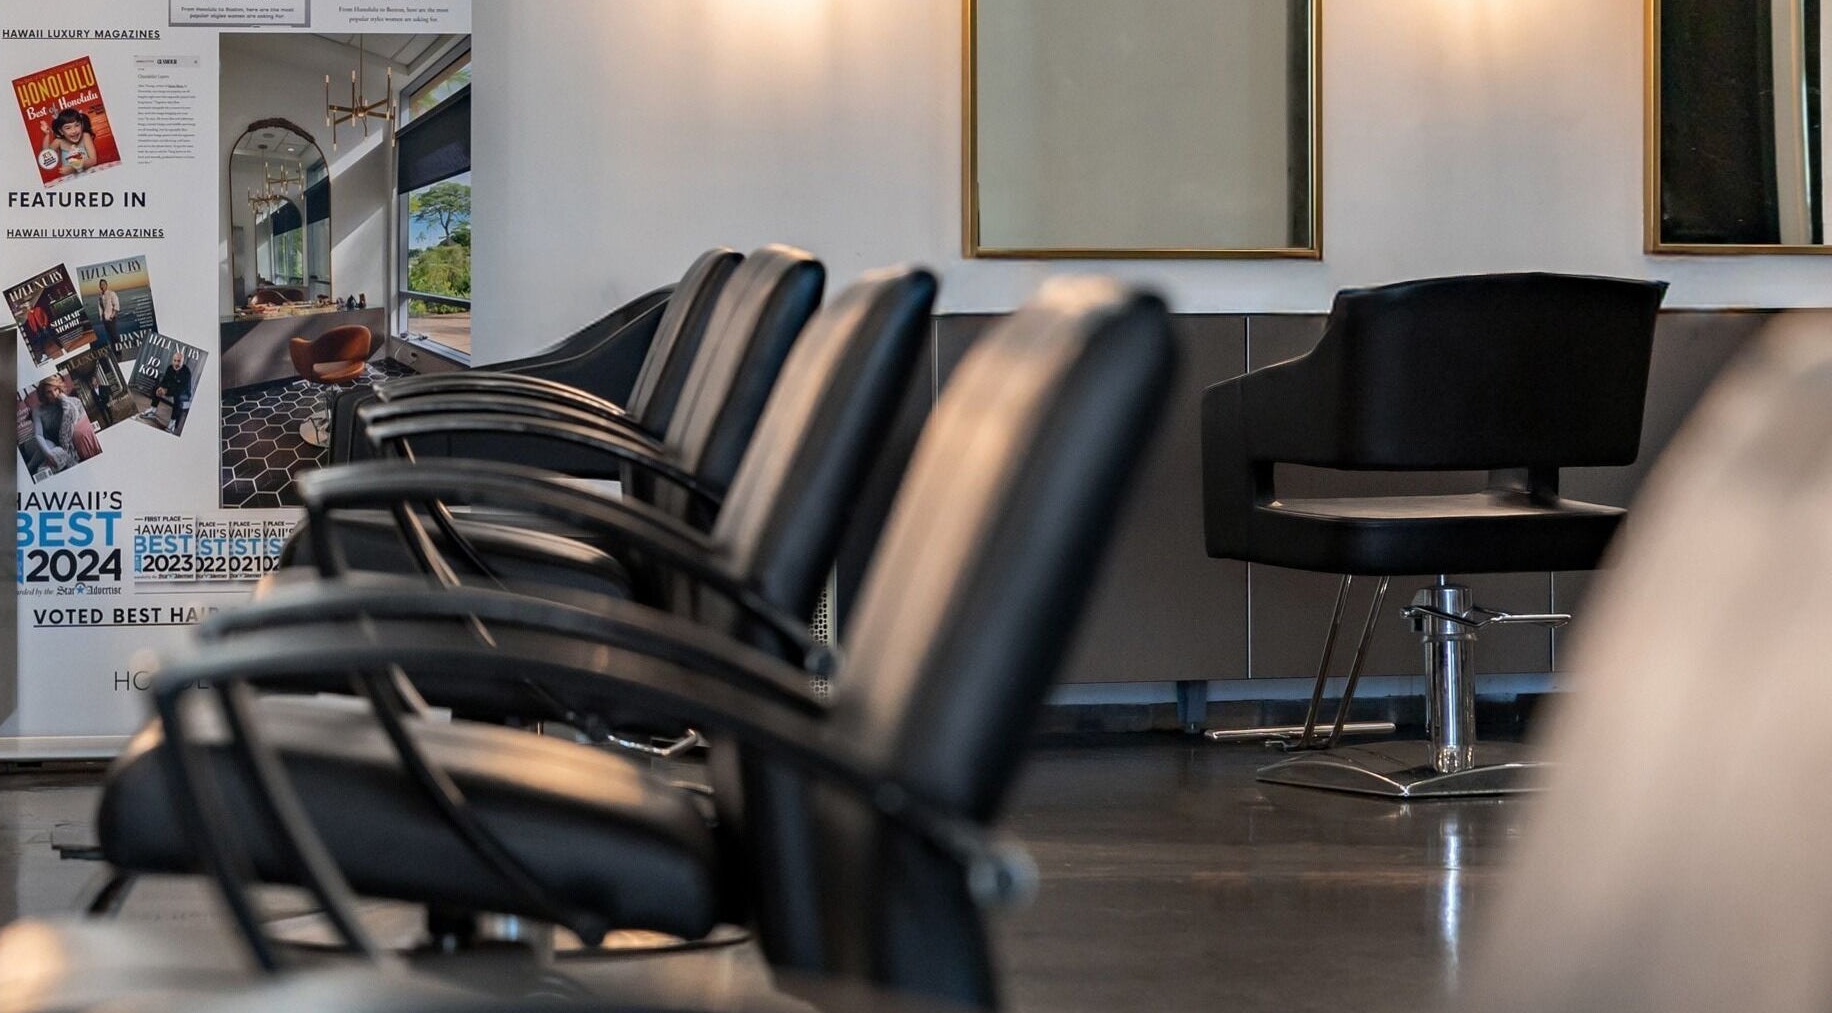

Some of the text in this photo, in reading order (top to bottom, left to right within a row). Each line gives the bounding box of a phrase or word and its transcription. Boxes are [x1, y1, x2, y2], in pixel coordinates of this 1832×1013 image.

[3, 30, 160, 38] HAWAII LUXURY MAGAZINES
[18, 64, 95, 108] HONOLULU
[27, 106, 47, 121] Best
[49, 103, 59, 117] of
[58, 92, 98, 110] Honolulu
[9, 192, 145, 207] FEATURED IN
[7, 229, 164, 237] HAWAII LUXURY MAGAZINES
[50, 311, 81, 327] SHEMAR
[55, 321, 81, 335] MOORE
[119, 329, 152, 342] DANI
[147, 356, 161, 368] JO
[139, 364, 160, 379] KOY
[17, 511, 122, 547] BEST
[134, 535, 193, 554] BEST
[26, 548, 121, 582] 2024
[143, 554, 193, 572] 2023
[196, 556, 226, 572] 022
[229, 557, 262, 572] 021
[36, 588, 43, 597] by
[56, 586, 75, 595] Star
[33, 609, 103, 624] VOTED
[114, 608, 162, 623] BEST
